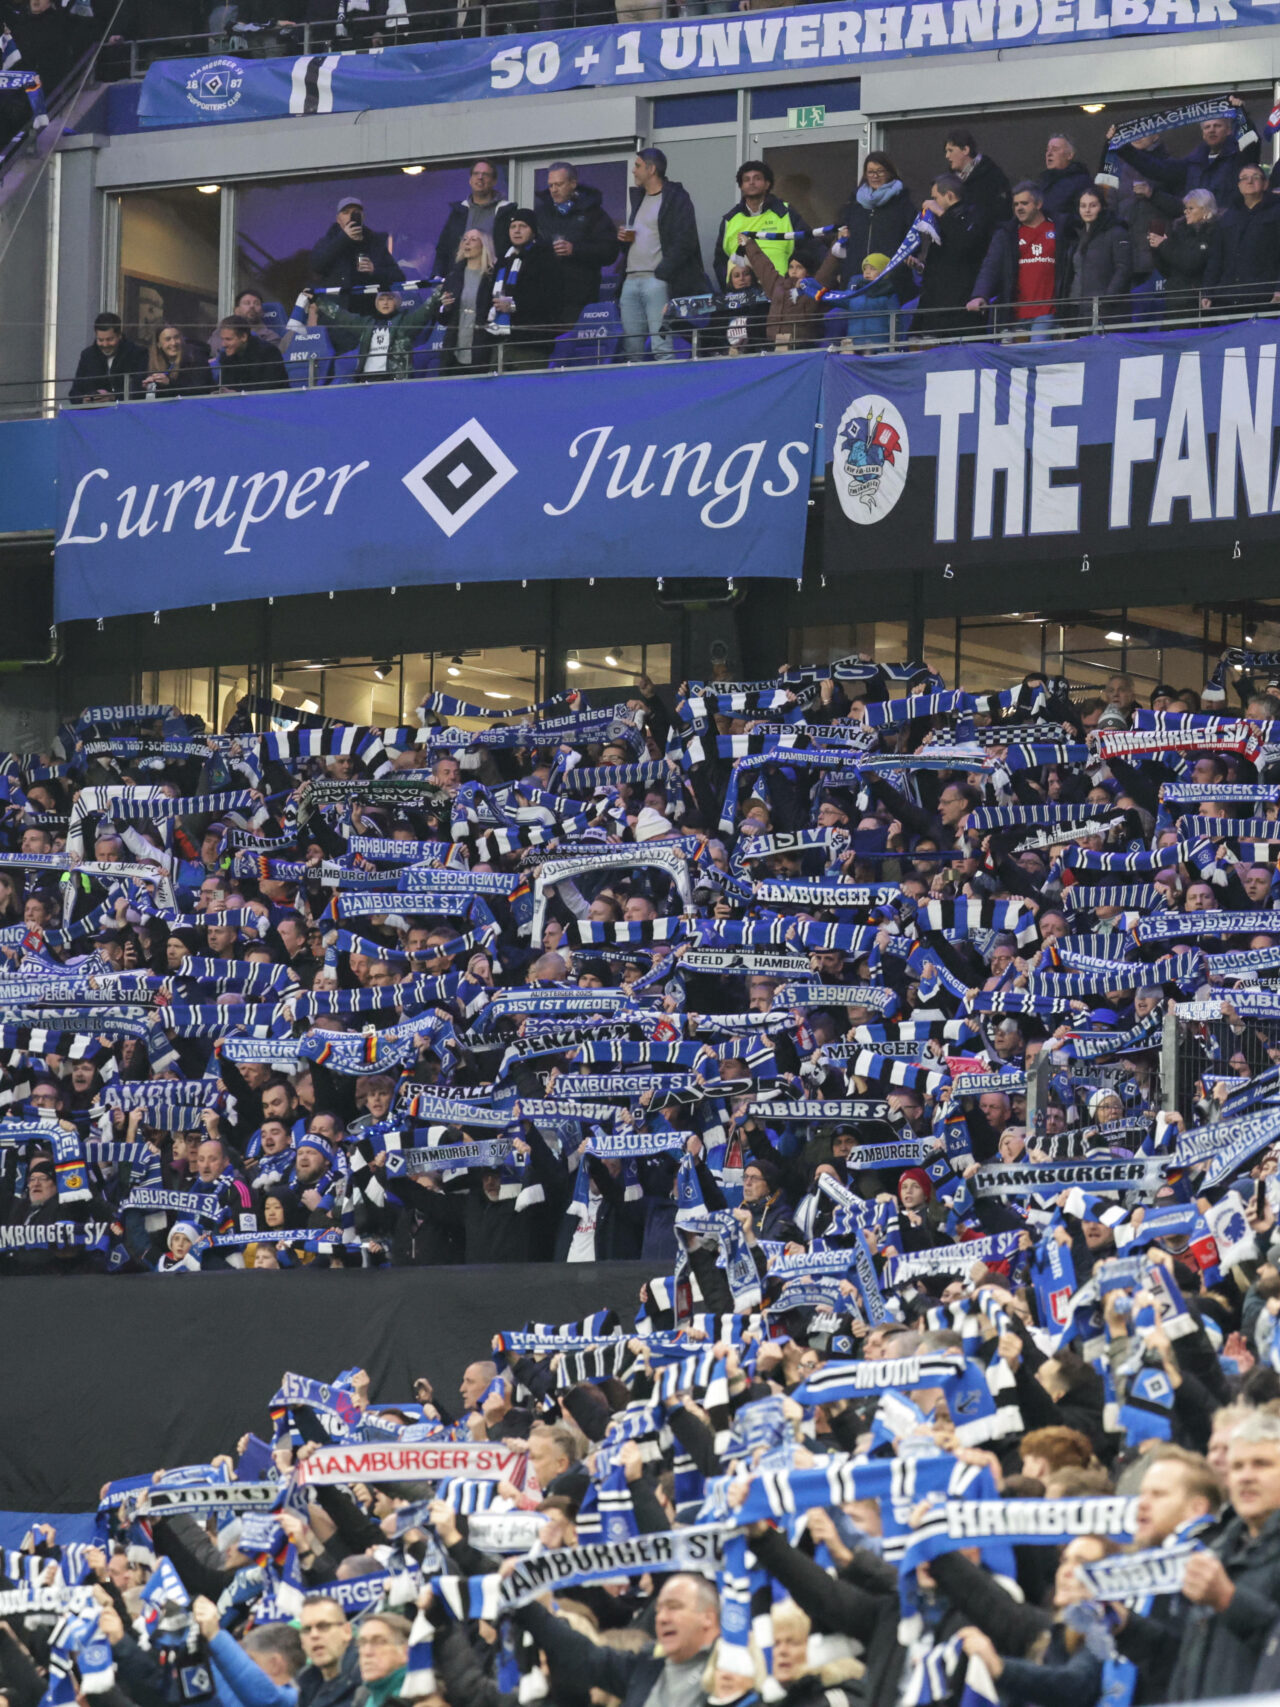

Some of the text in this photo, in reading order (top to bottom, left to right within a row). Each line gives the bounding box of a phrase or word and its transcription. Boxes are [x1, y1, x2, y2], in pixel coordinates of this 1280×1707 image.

[491, 41, 560, 89] 50
[574, 46, 599, 75] +
[615, 31, 644, 75] 1
[186, 78, 242, 90] 18 87
[186, 91, 241, 111] SUPPORTERS CLUB
[1112, 101, 1229, 145] SEXMACHINES
[295, 333, 320, 342] RECARO
[578, 329, 598, 339] HSV
[290, 352, 308, 362] HSV
[924, 362, 1085, 543] THE
[56, 425, 810, 555] Luruper Jungs
[539, 709, 614, 730] TREUE RIEGE
[480, 732, 505, 743] 1983
[532, 735, 560, 745] 1977
[1103, 724, 1248, 754] HAMBURGER SV
[84, 742, 123, 755] HAMBURG
[149, 742, 183, 753] SCHEISS
[350, 836, 418, 858] HAMBURGER
[540, 847, 685, 880] VOLKSPARKSTADION
[308, 867, 365, 881] HAMBURG
[367, 869, 402, 882] MEINE
[435, 870, 514, 889] HAMBURGER
[341, 894, 434, 913] HAMBURGER
[757, 882, 901, 907] HAMBURGER SV
[86, 989, 117, 1000] MEINE
[119, 989, 155, 1001] STADT
[507, 999, 620, 1012] HSV IST WIEDER
[1240, 1007, 1259, 1015] MEIN
[553, 1075, 665, 1092] HAMBURGER
[411, 1141, 508, 1162] HAMBURGER SV
[976, 1163, 1145, 1188] HAMBURGER
[84, 1222, 107, 1242] SV
[1047, 1238, 1063, 1279] SEHR
[307, 1449, 511, 1474] HAMBURGER SV
